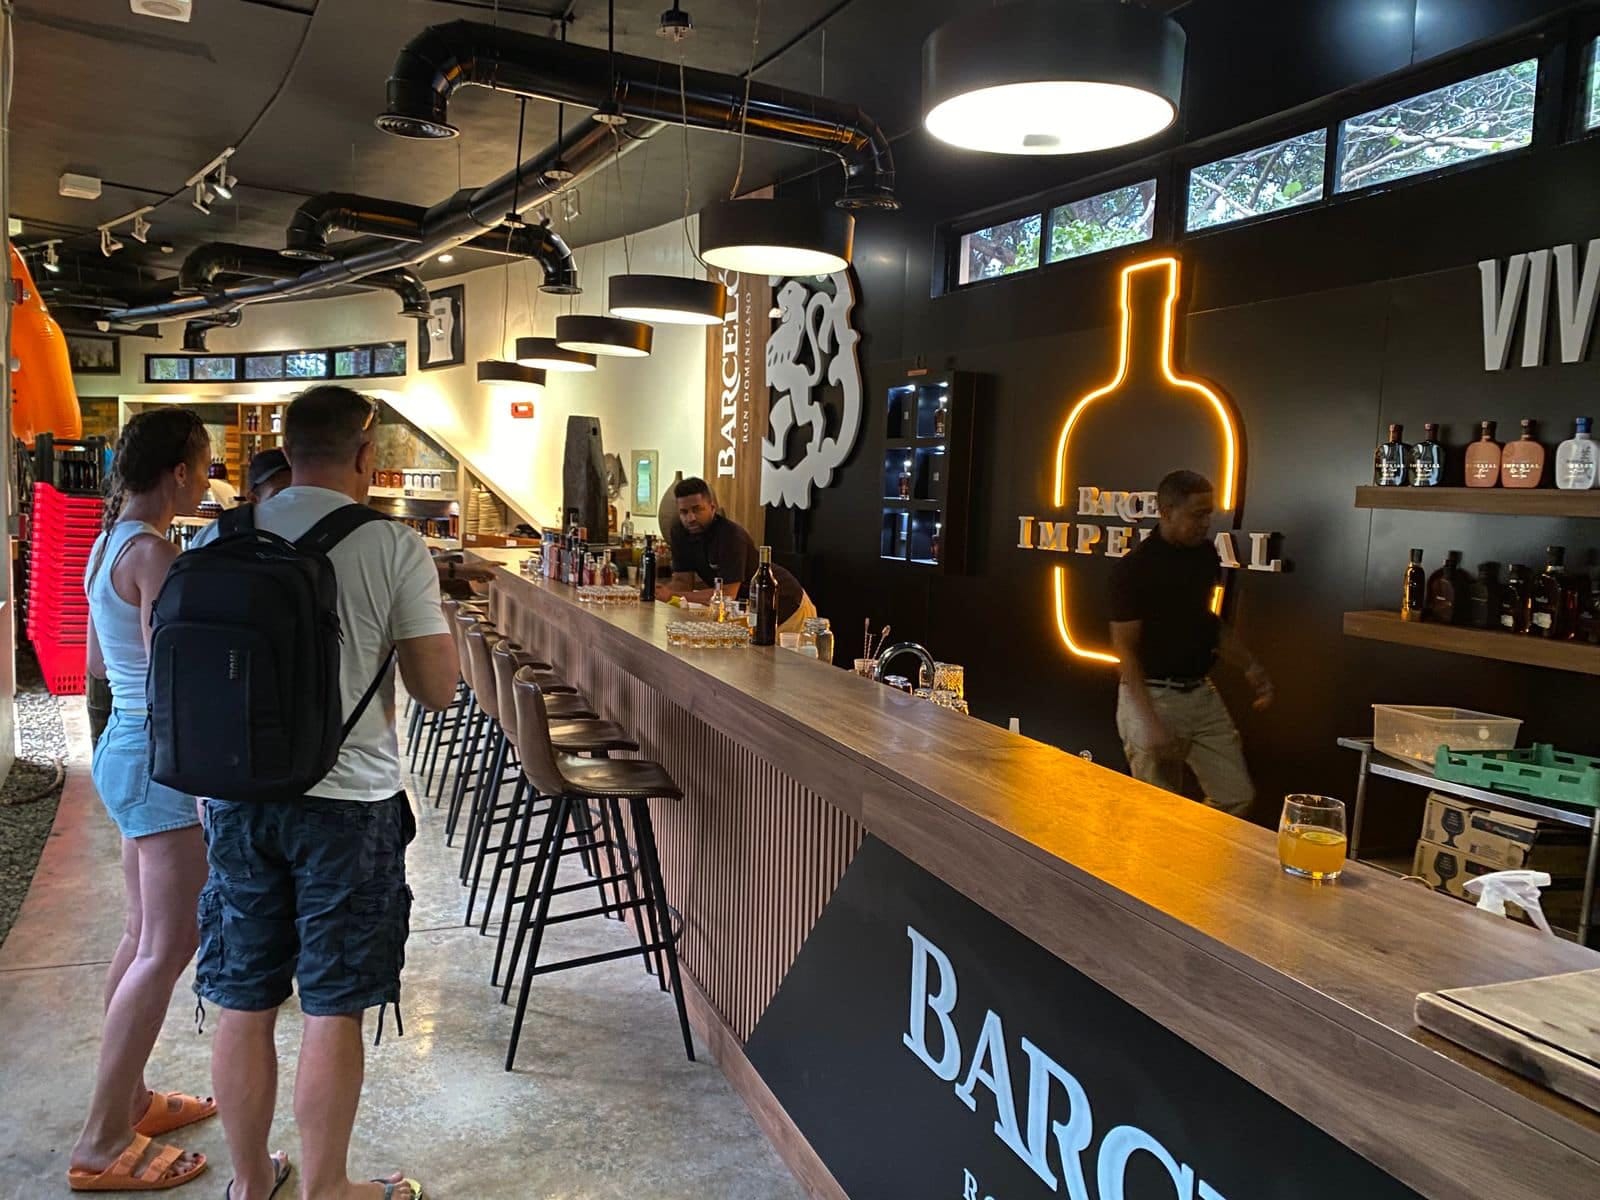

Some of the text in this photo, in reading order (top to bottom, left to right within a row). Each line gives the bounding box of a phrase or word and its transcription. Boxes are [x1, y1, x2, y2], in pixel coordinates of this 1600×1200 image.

[742, 292, 752, 443] RON DOMINICANO
[1017, 515, 1282, 572] IMPEAL
[1076, 486, 1162, 523] BARCE
[903, 925, 1228, 1200] BARC
